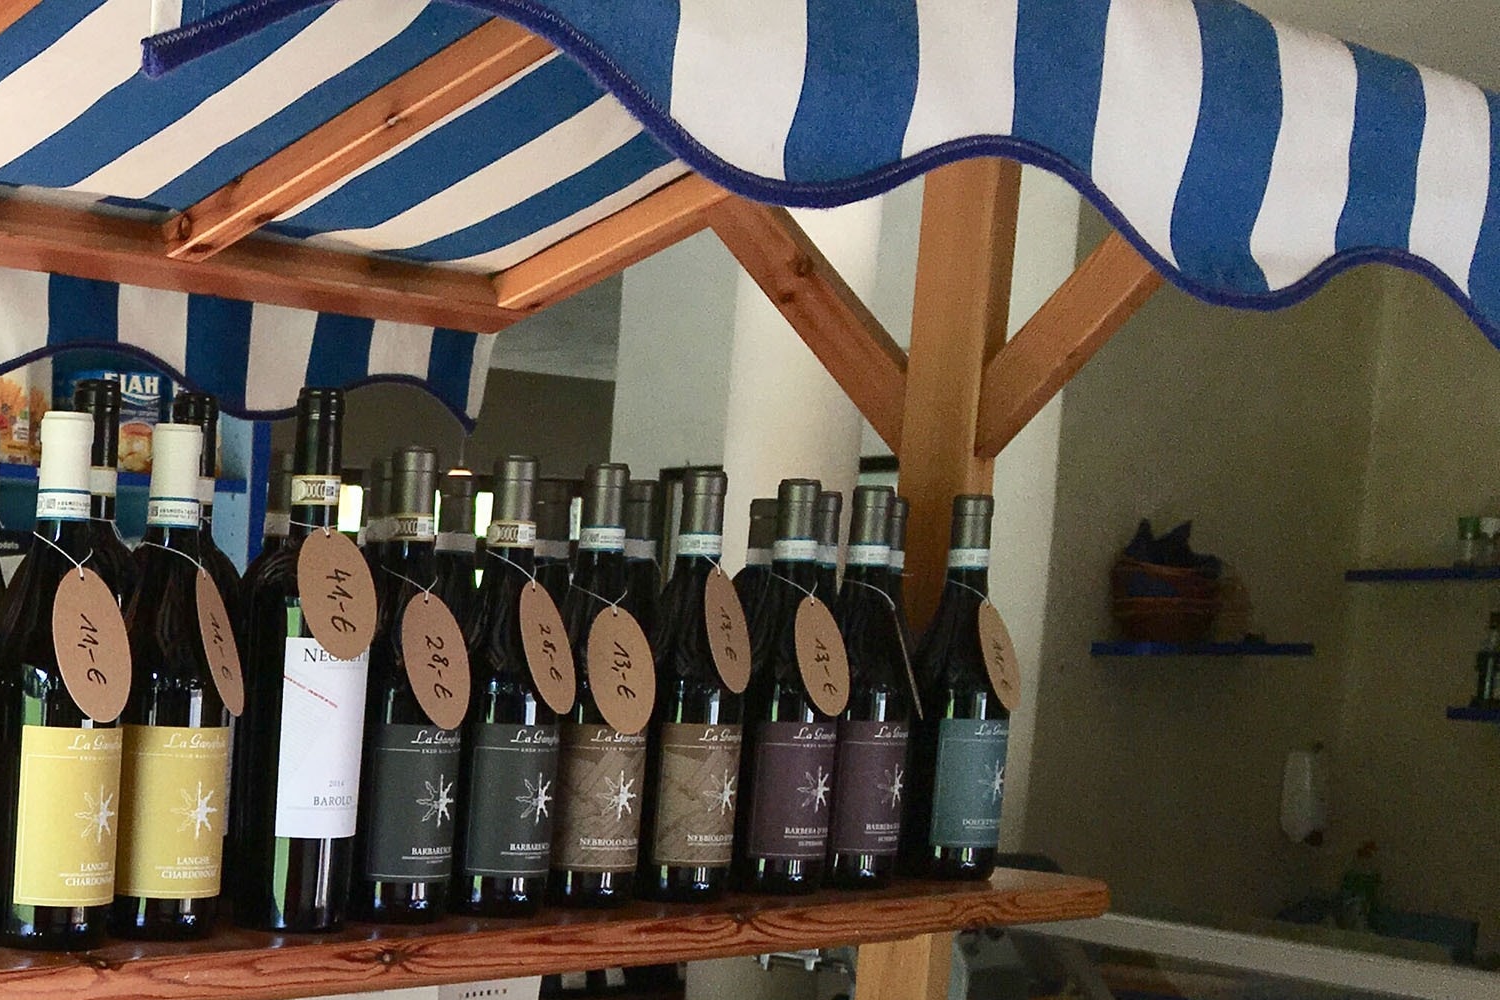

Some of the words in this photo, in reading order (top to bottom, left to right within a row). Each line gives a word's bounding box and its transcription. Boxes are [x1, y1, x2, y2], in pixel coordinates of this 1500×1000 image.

[67, 734, 91, 750] La
[163, 733, 187, 748] La
[411, 730, 433, 745] La
[510, 730, 532, 745] La
[591, 730, 613, 745] La
[313, 796, 352, 806] BAROLO
